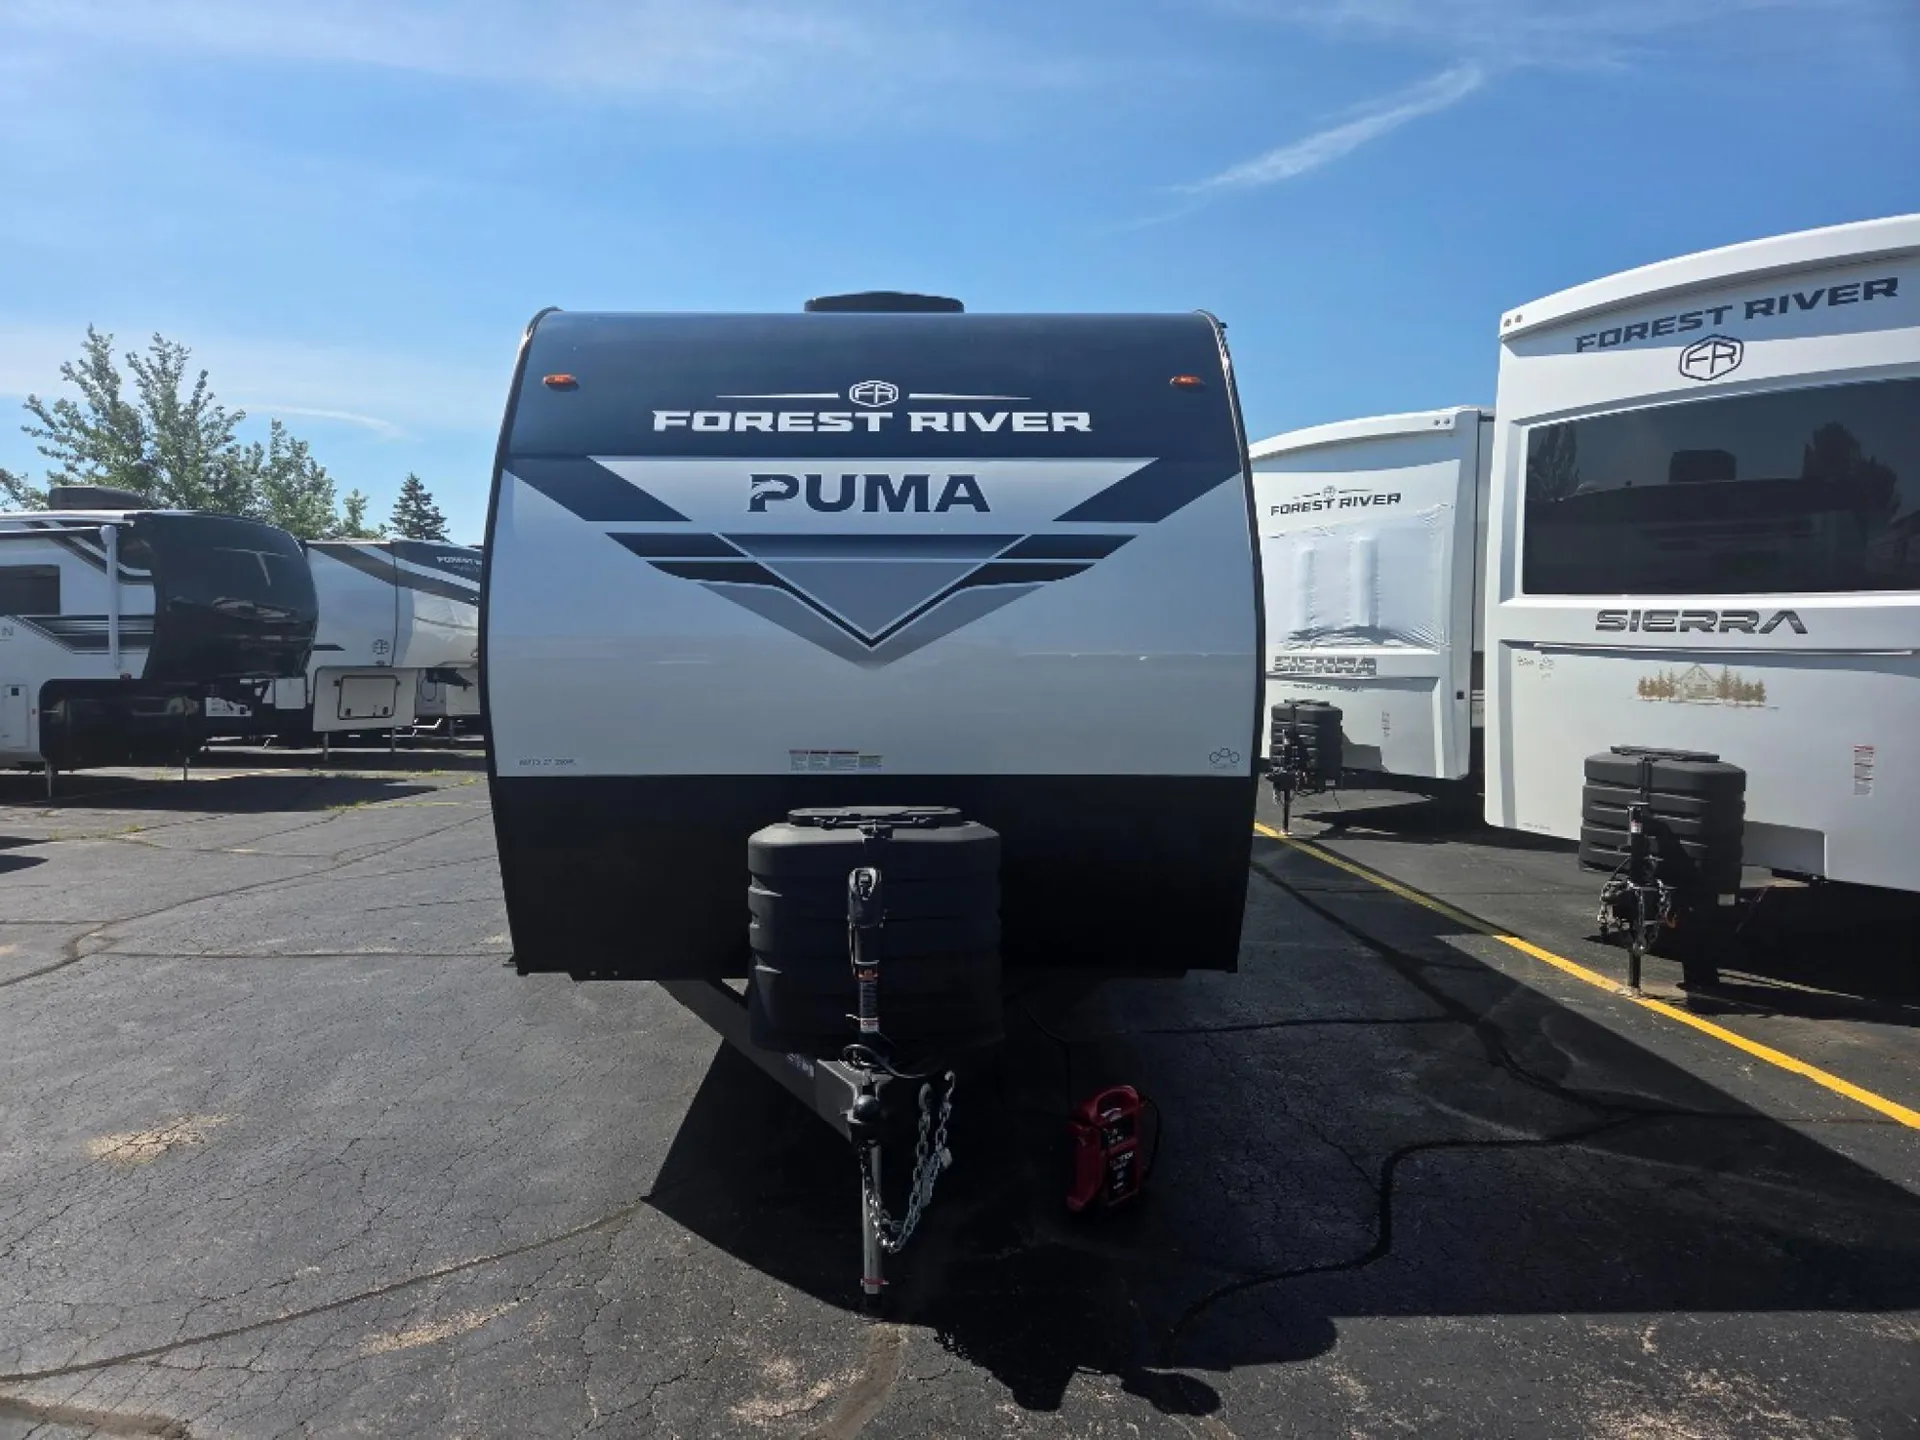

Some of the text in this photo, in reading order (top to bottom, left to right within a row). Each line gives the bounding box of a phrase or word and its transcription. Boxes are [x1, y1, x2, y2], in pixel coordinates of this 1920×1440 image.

[1575, 276, 1899, 353] FOREST RIVER
[652, 410, 1093, 432] FOREST RIVER
[747, 473, 991, 513] PUMA
[1270, 492, 1402, 516] FOREST RIVER
[1595, 609, 1808, 635] SIERRA
